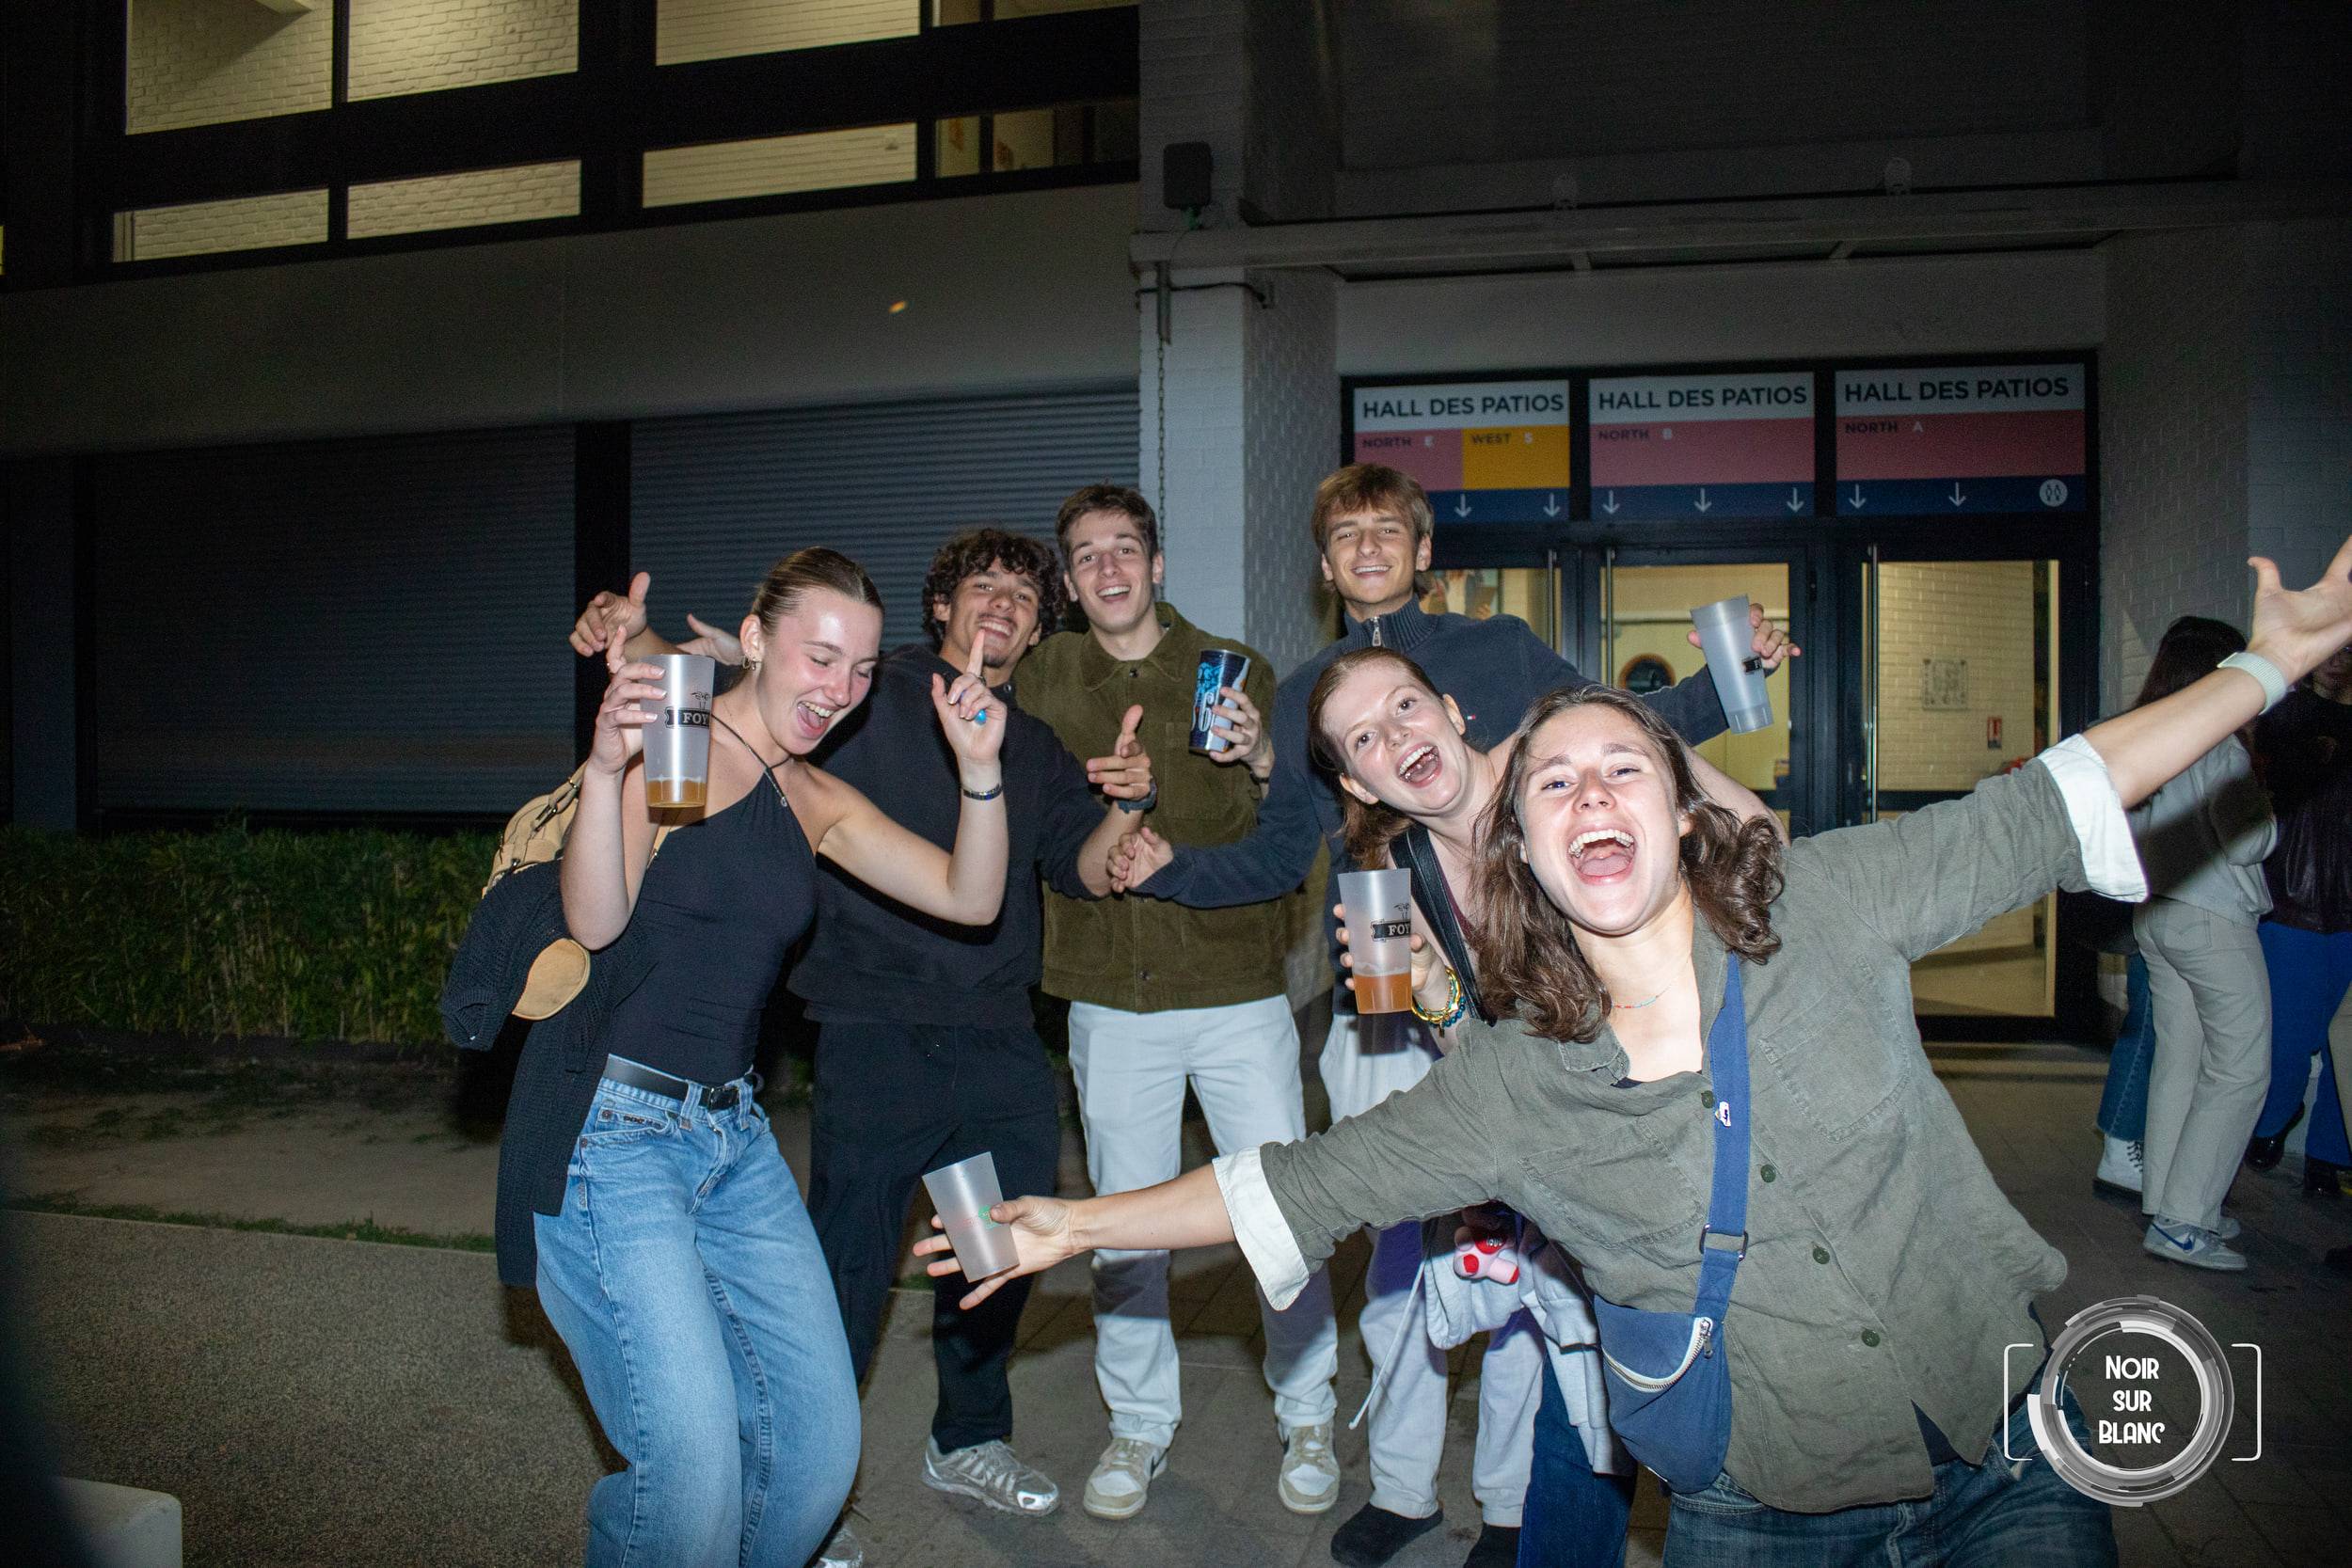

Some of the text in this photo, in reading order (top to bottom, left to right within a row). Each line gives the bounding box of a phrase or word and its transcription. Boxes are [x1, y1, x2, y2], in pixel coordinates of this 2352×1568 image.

[1845, 377, 2070, 402] HALL DES PATIOS
[1598, 386, 1806, 409] HALL DES PATIOS
[1363, 394, 1564, 418] HALL DES PATIOS
[1845, 420, 1924, 433] NORTH A
[1470, 433, 1510, 445] WEST
[1597, 429, 1649, 440] NORTH
[1362, 436, 1411, 449] NORTH
